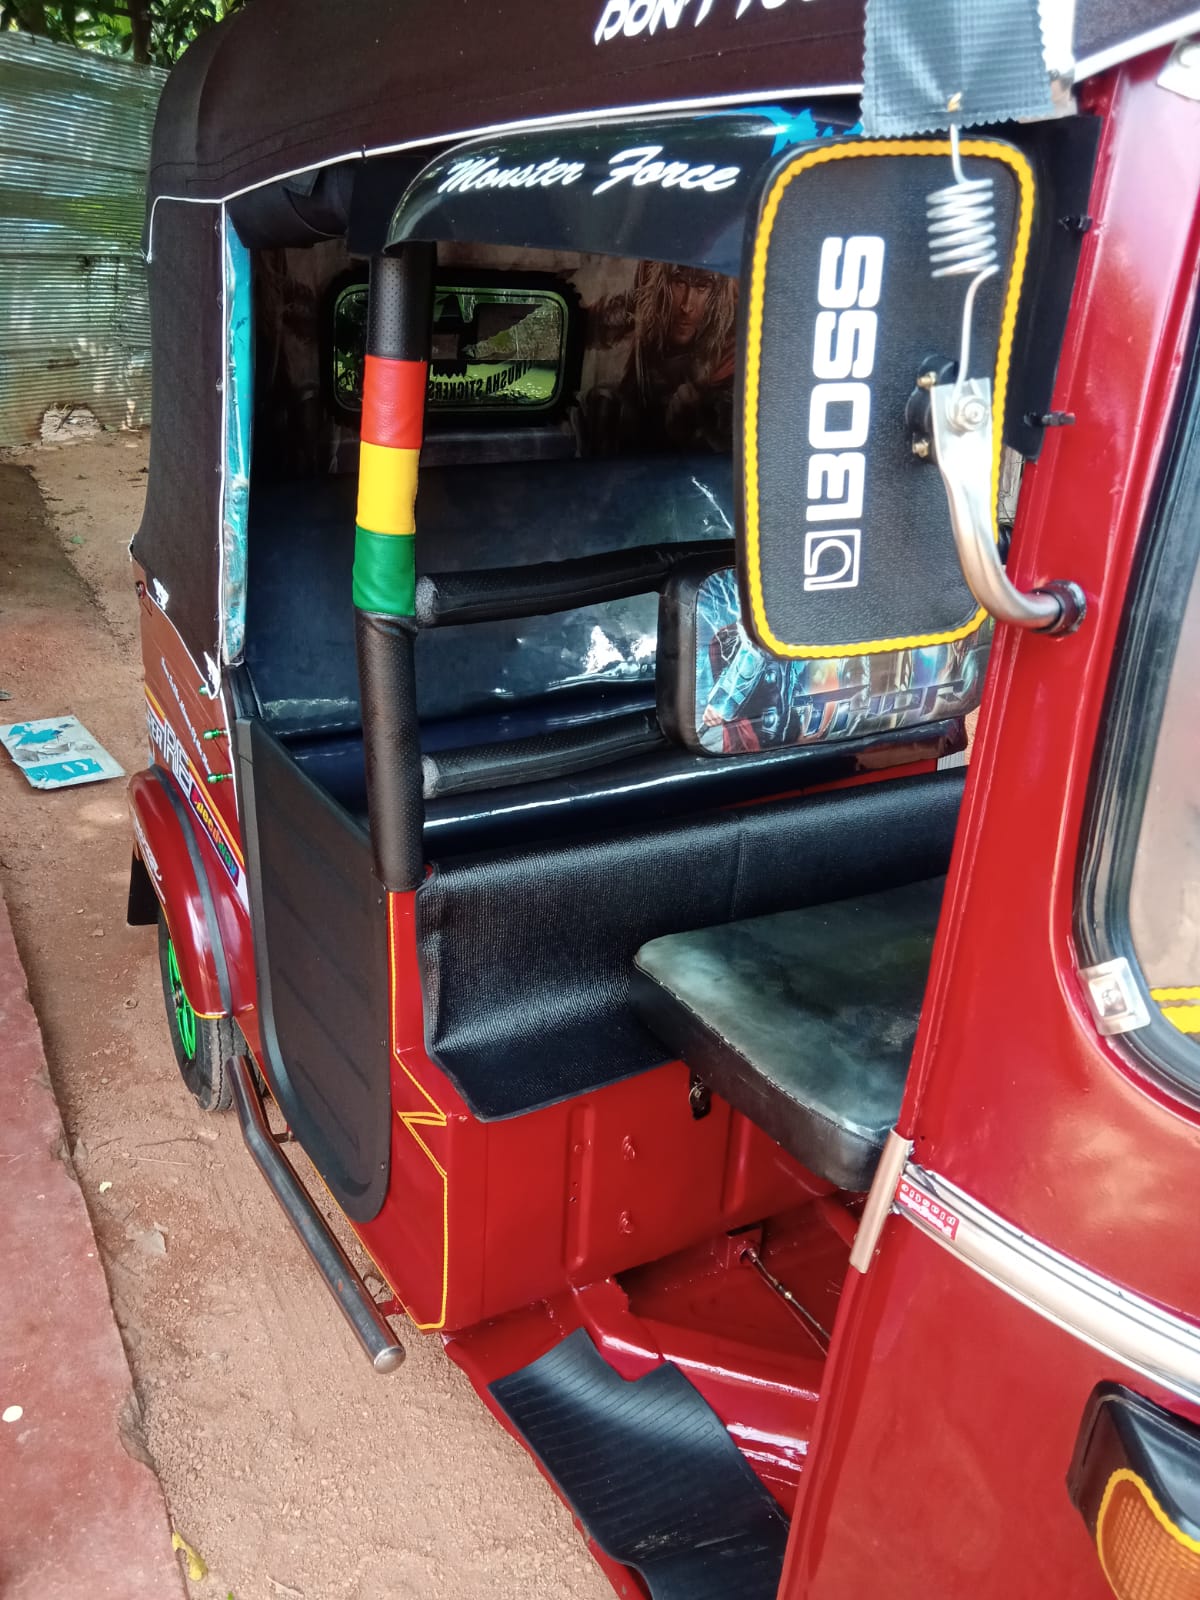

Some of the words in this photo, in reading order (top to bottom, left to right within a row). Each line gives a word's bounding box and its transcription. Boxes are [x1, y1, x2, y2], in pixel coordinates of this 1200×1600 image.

[594, 0, 715, 45] DON
[438, 156, 585, 193] Monster
[592, 145, 741, 196] Force
[805, 235, 885, 521] BOSS
